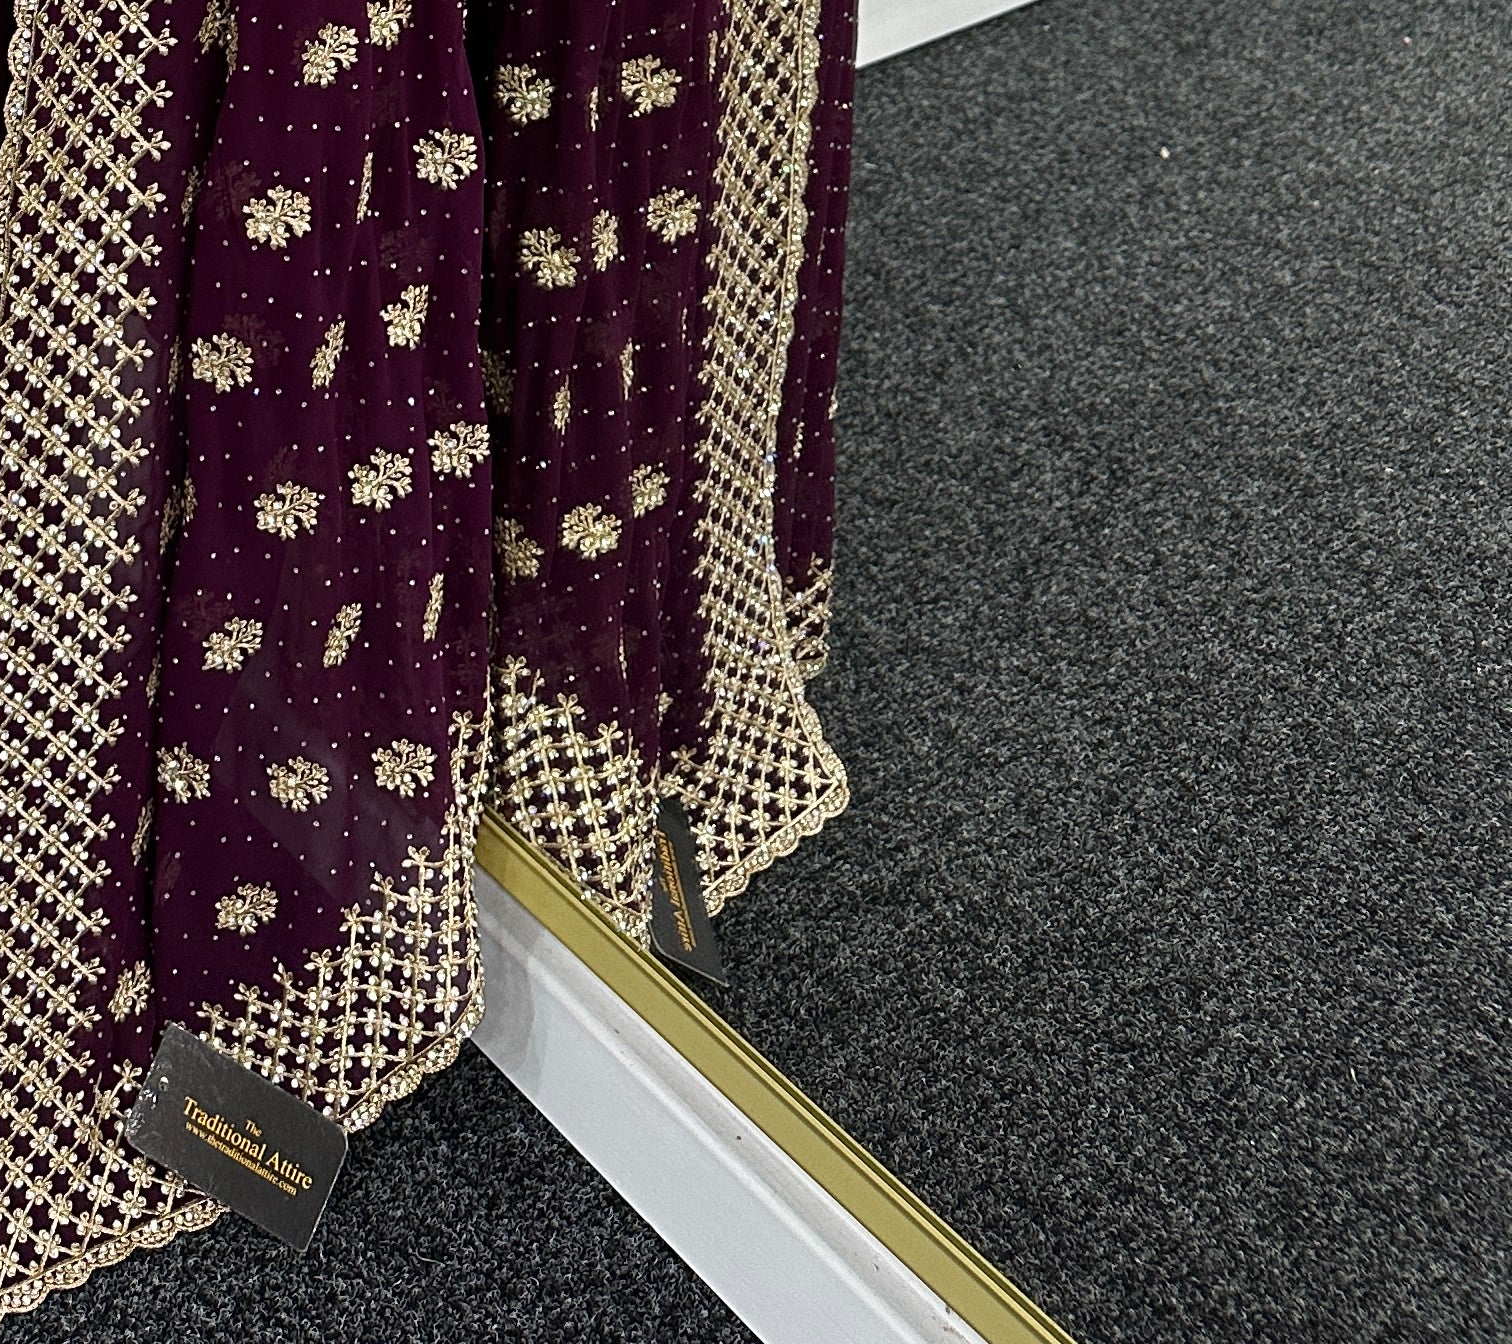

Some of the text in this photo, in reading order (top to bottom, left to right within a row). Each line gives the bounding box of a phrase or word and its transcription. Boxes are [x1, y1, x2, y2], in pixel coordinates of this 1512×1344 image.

[183, 1096, 313, 1190] Traditional Attire
[245, 1119, 263, 1137] The
